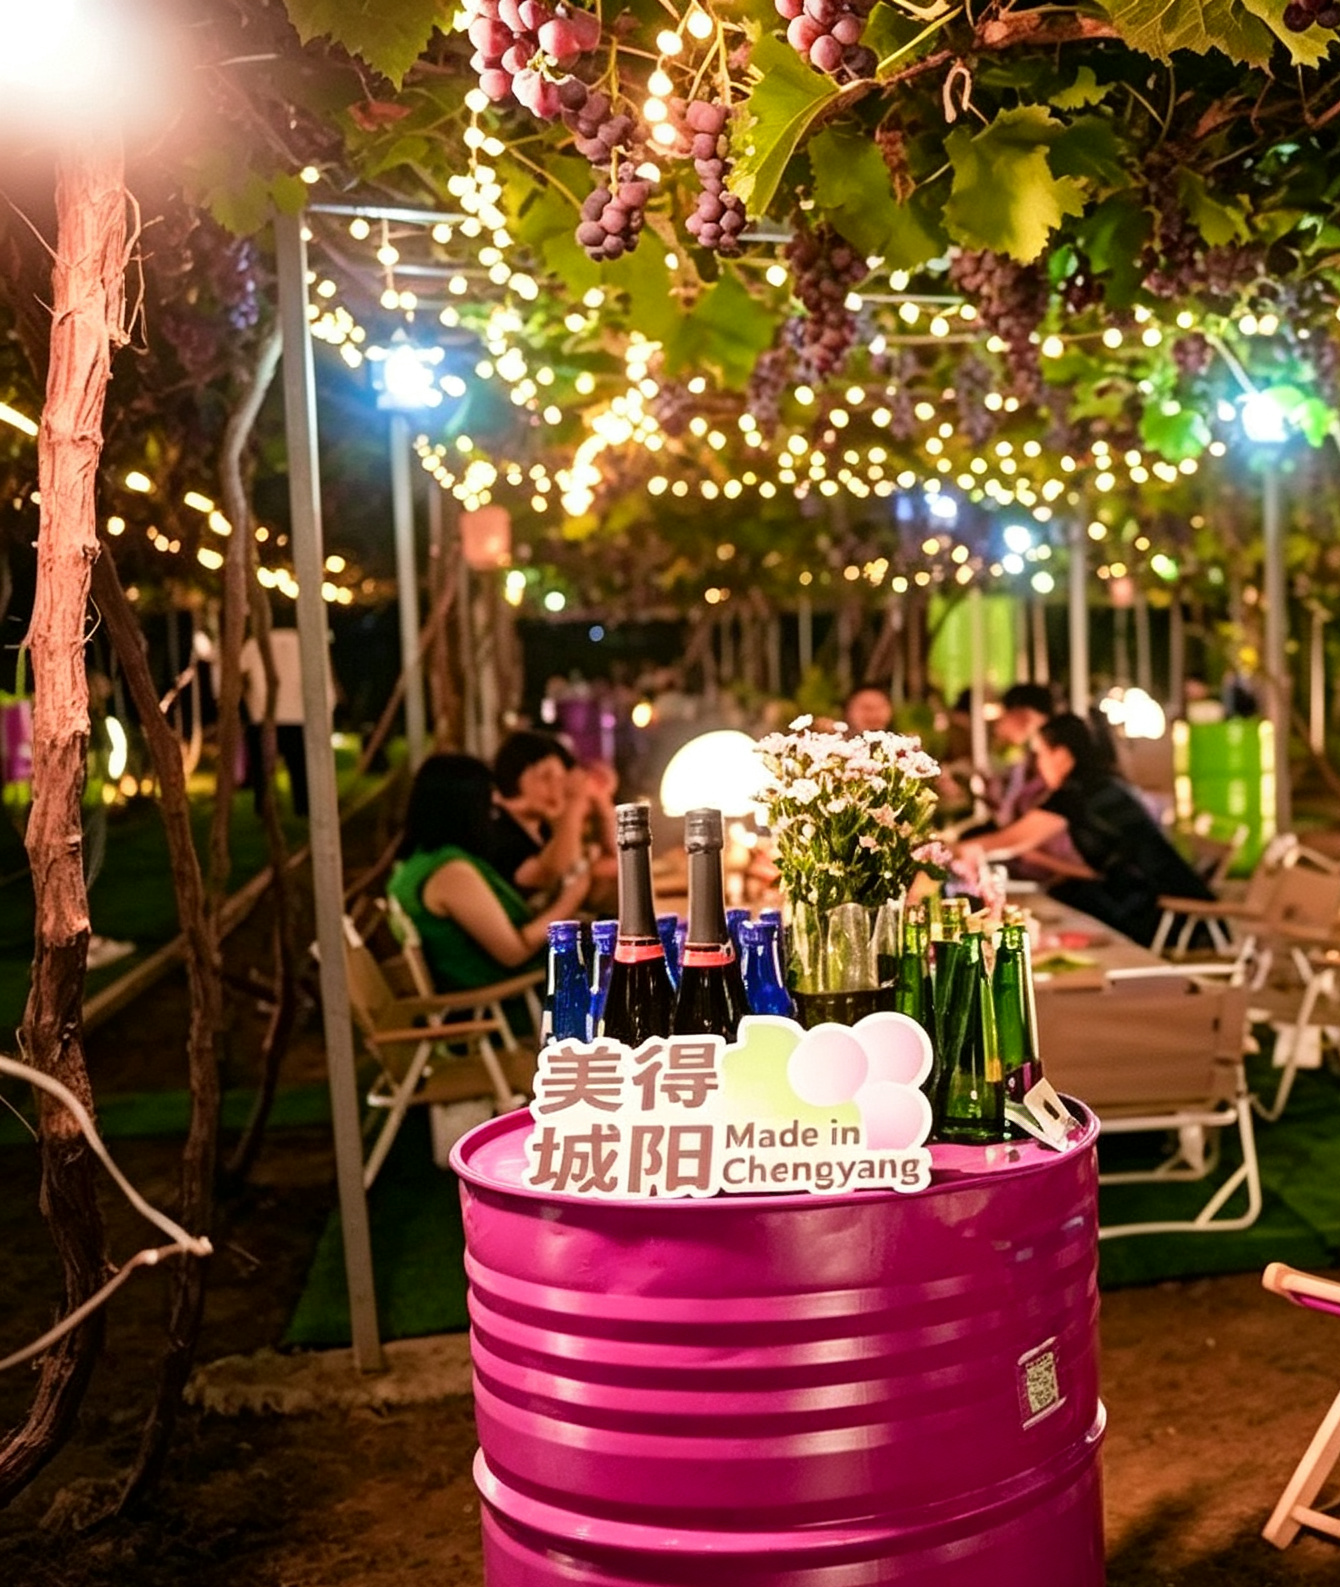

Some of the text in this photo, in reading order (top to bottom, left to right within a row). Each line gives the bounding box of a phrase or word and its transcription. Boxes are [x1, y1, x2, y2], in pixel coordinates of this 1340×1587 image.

[537, 1042, 719, 1115] 美得
[529, 1123, 714, 1193] 城阳
[725, 1119, 861, 1149] Made in
[722, 1155, 921, 1190] Chengyang
